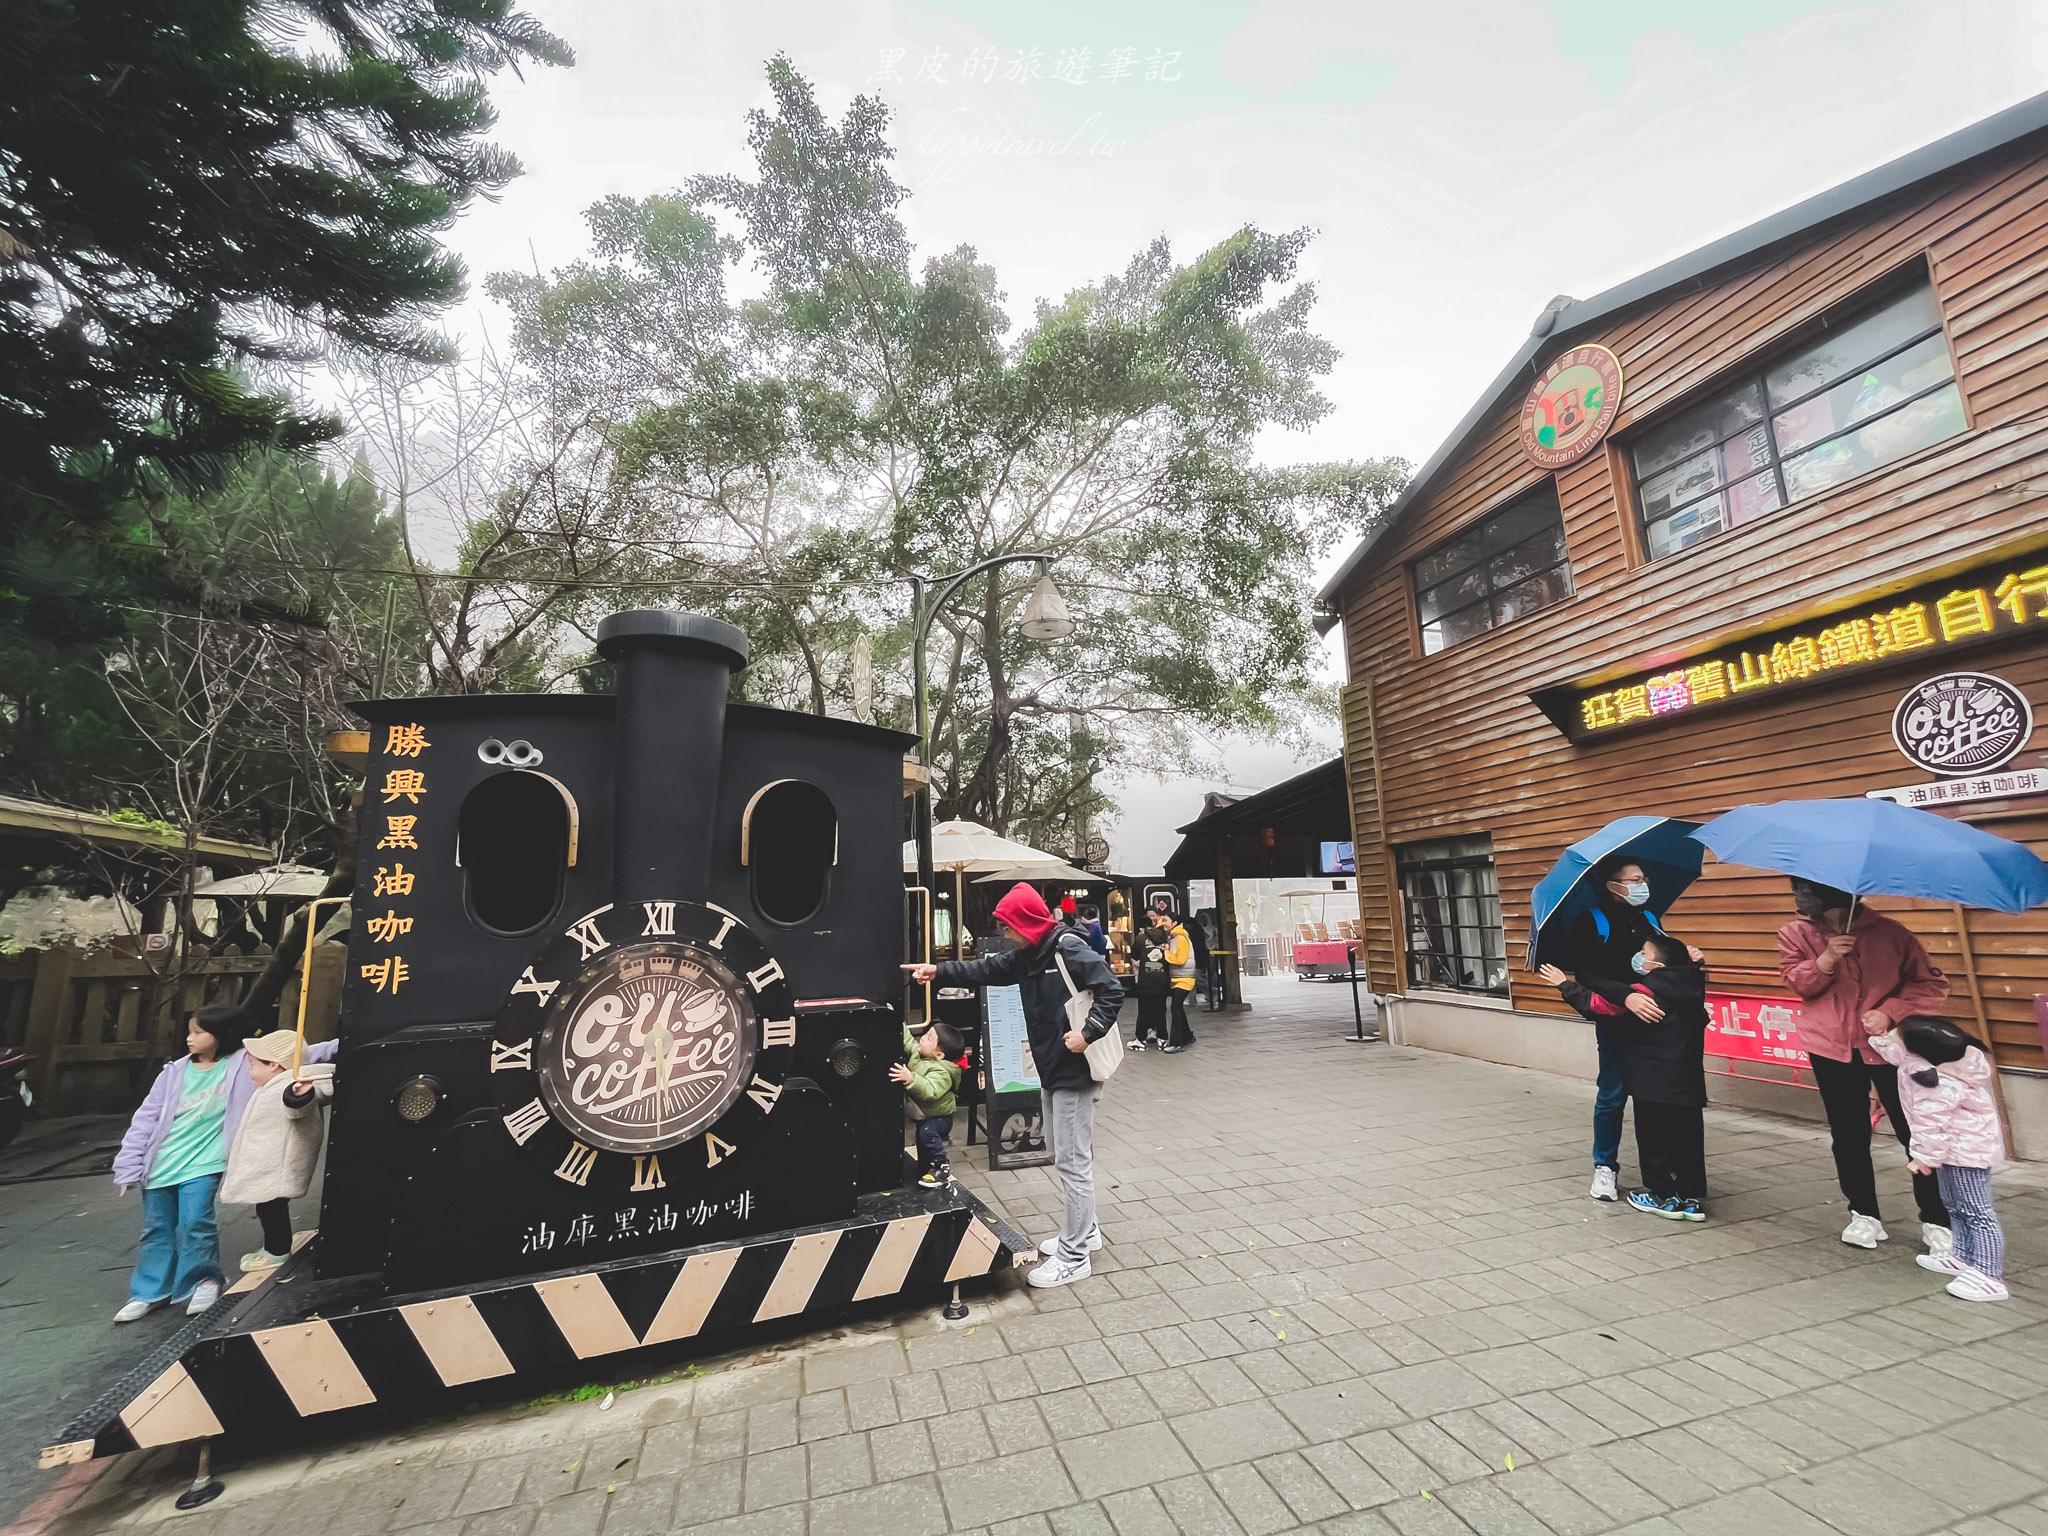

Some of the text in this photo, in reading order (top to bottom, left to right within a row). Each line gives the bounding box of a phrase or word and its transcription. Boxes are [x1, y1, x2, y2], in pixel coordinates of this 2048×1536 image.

[1523, 432, 1537, 453] Old
[1533, 446, 1575, 464] Mountain
[1575, 429, 1599, 454] Line
[1597, 405, 1614, 430] Rail
[1909, 773, 2039, 803] 油庫黑油咖啡
[360, 722, 432, 995] 勝興黑油咖啡
[565, 917, 611, 961] XI
[641, 902, 676, 936] XII
[511, 965, 561, 1007] X
[1704, 1001, 1801, 1041] 止停
